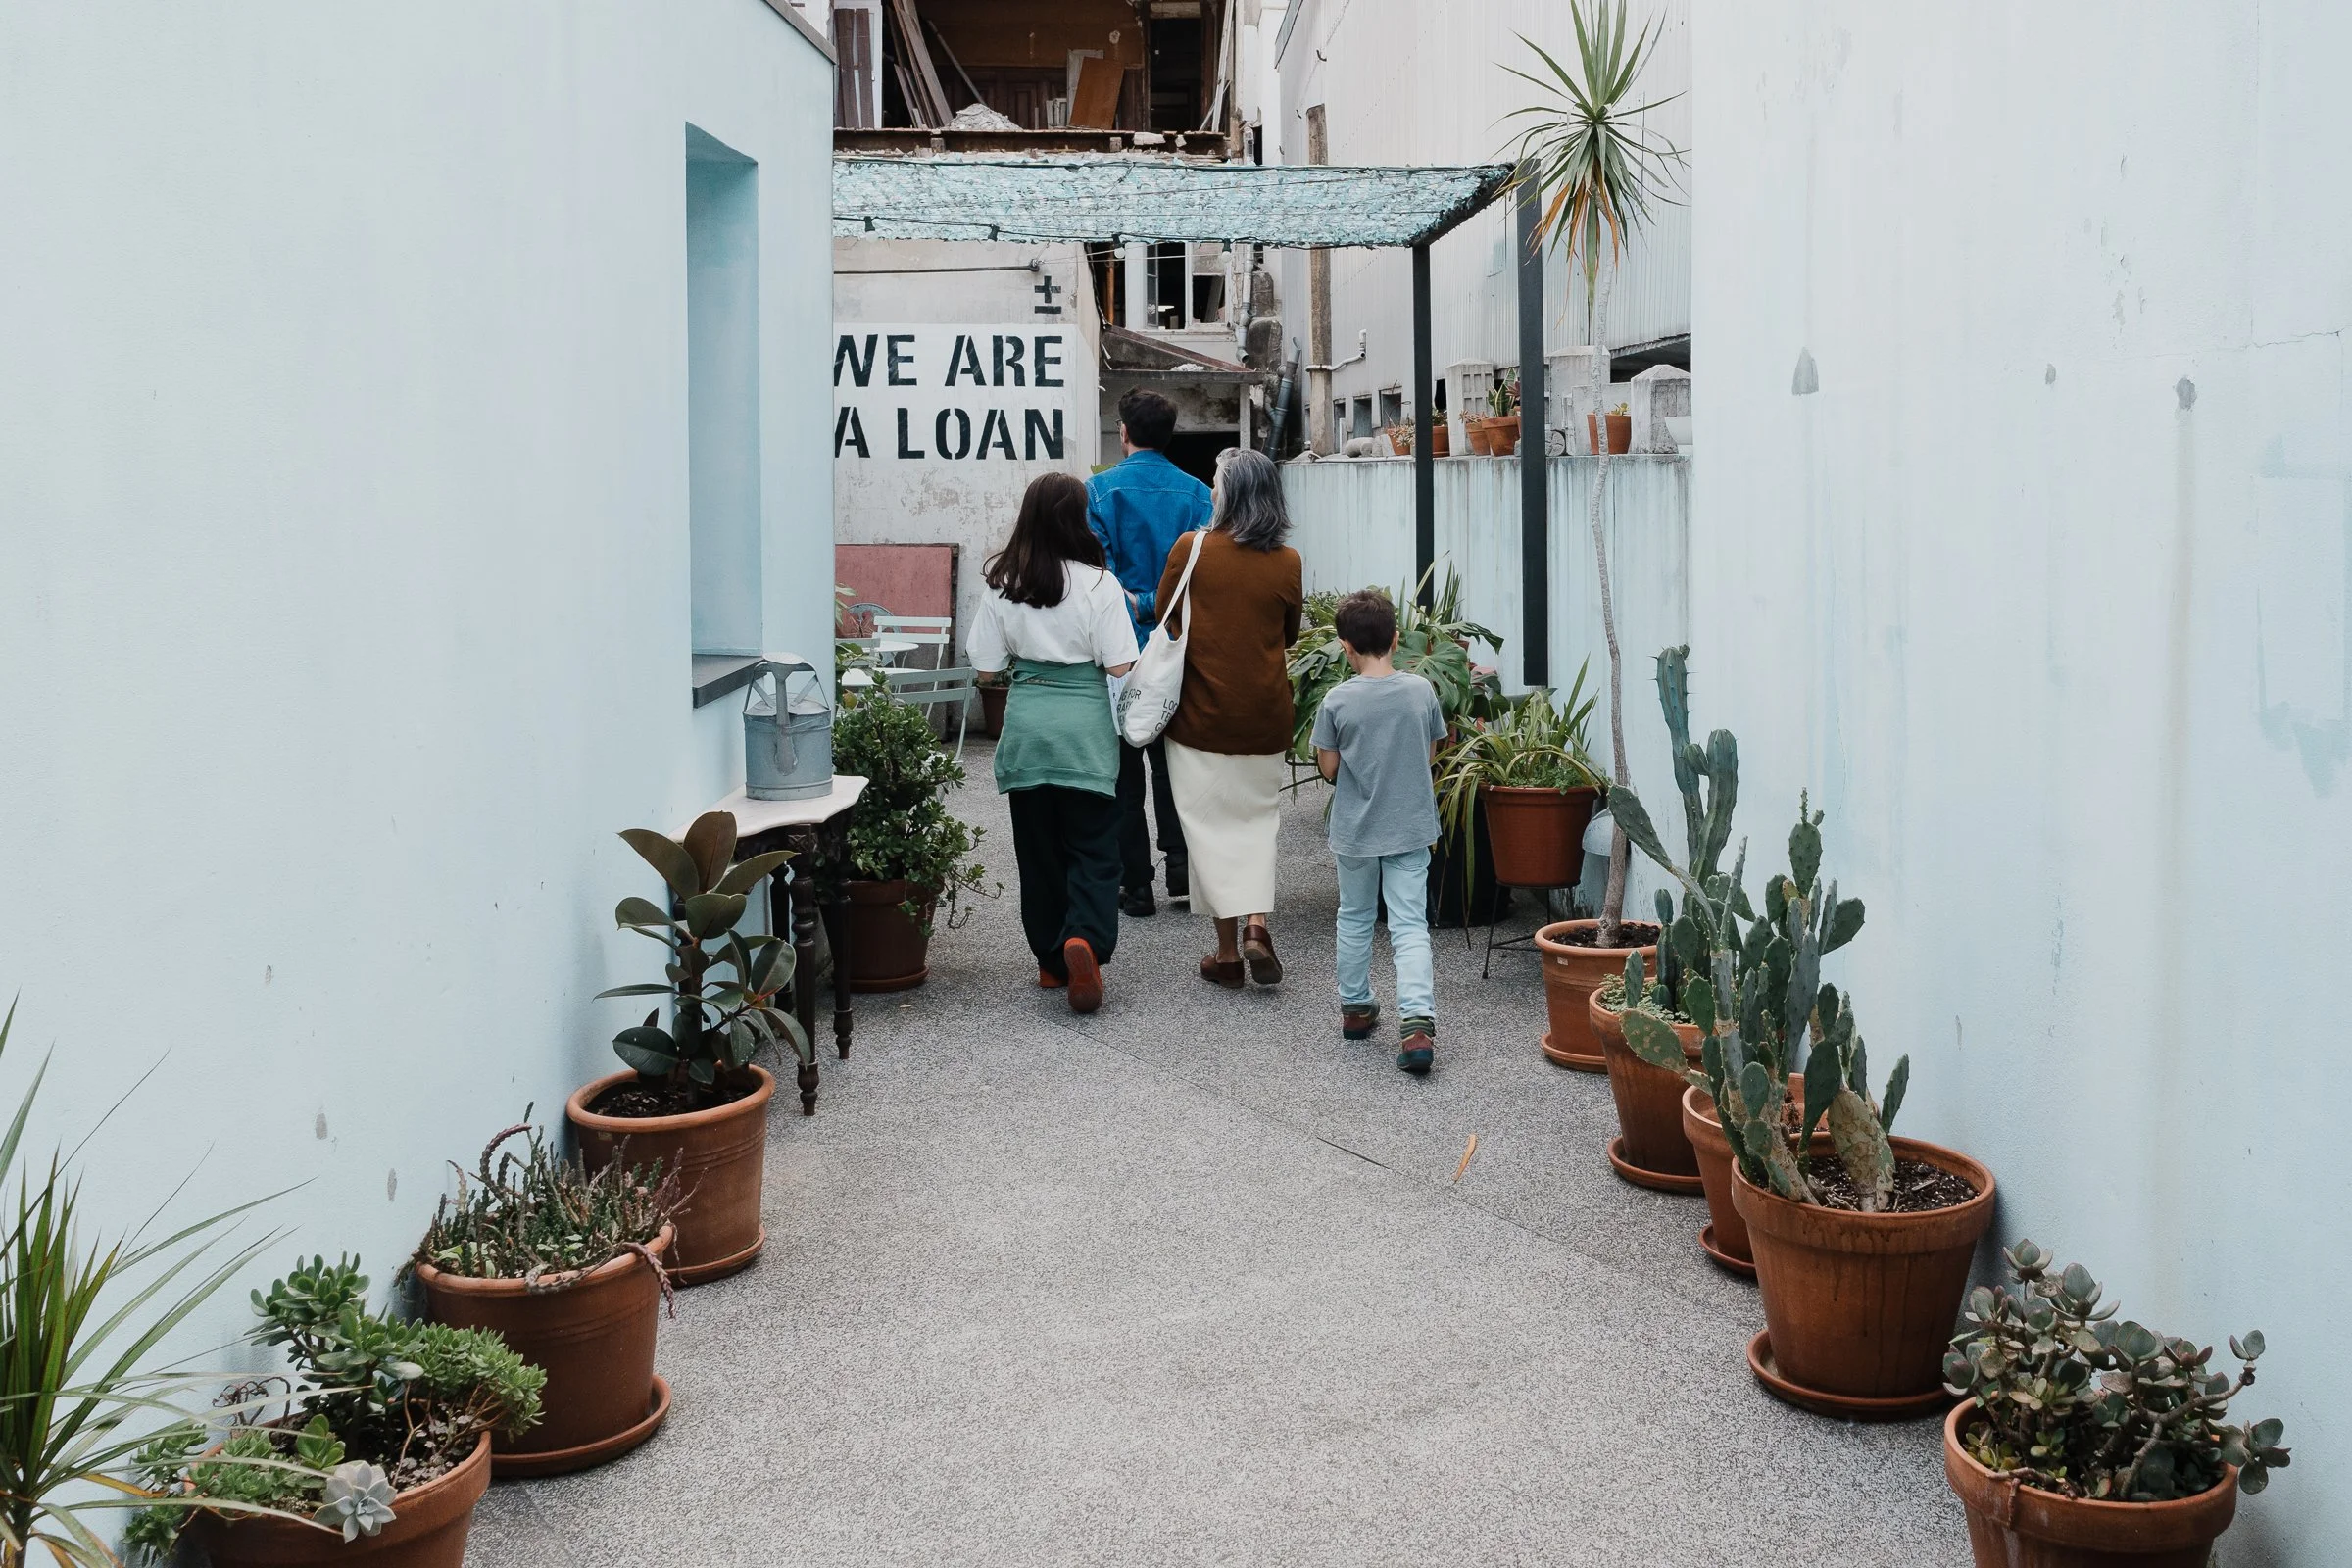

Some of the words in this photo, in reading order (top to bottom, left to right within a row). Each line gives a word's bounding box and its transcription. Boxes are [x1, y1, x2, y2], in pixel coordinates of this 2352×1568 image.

[833, 334, 917, 387] WE
[944, 335, 1064, 387] ARE
[834, 406, 870, 459] A
[897, 408, 1064, 460] LOAN
